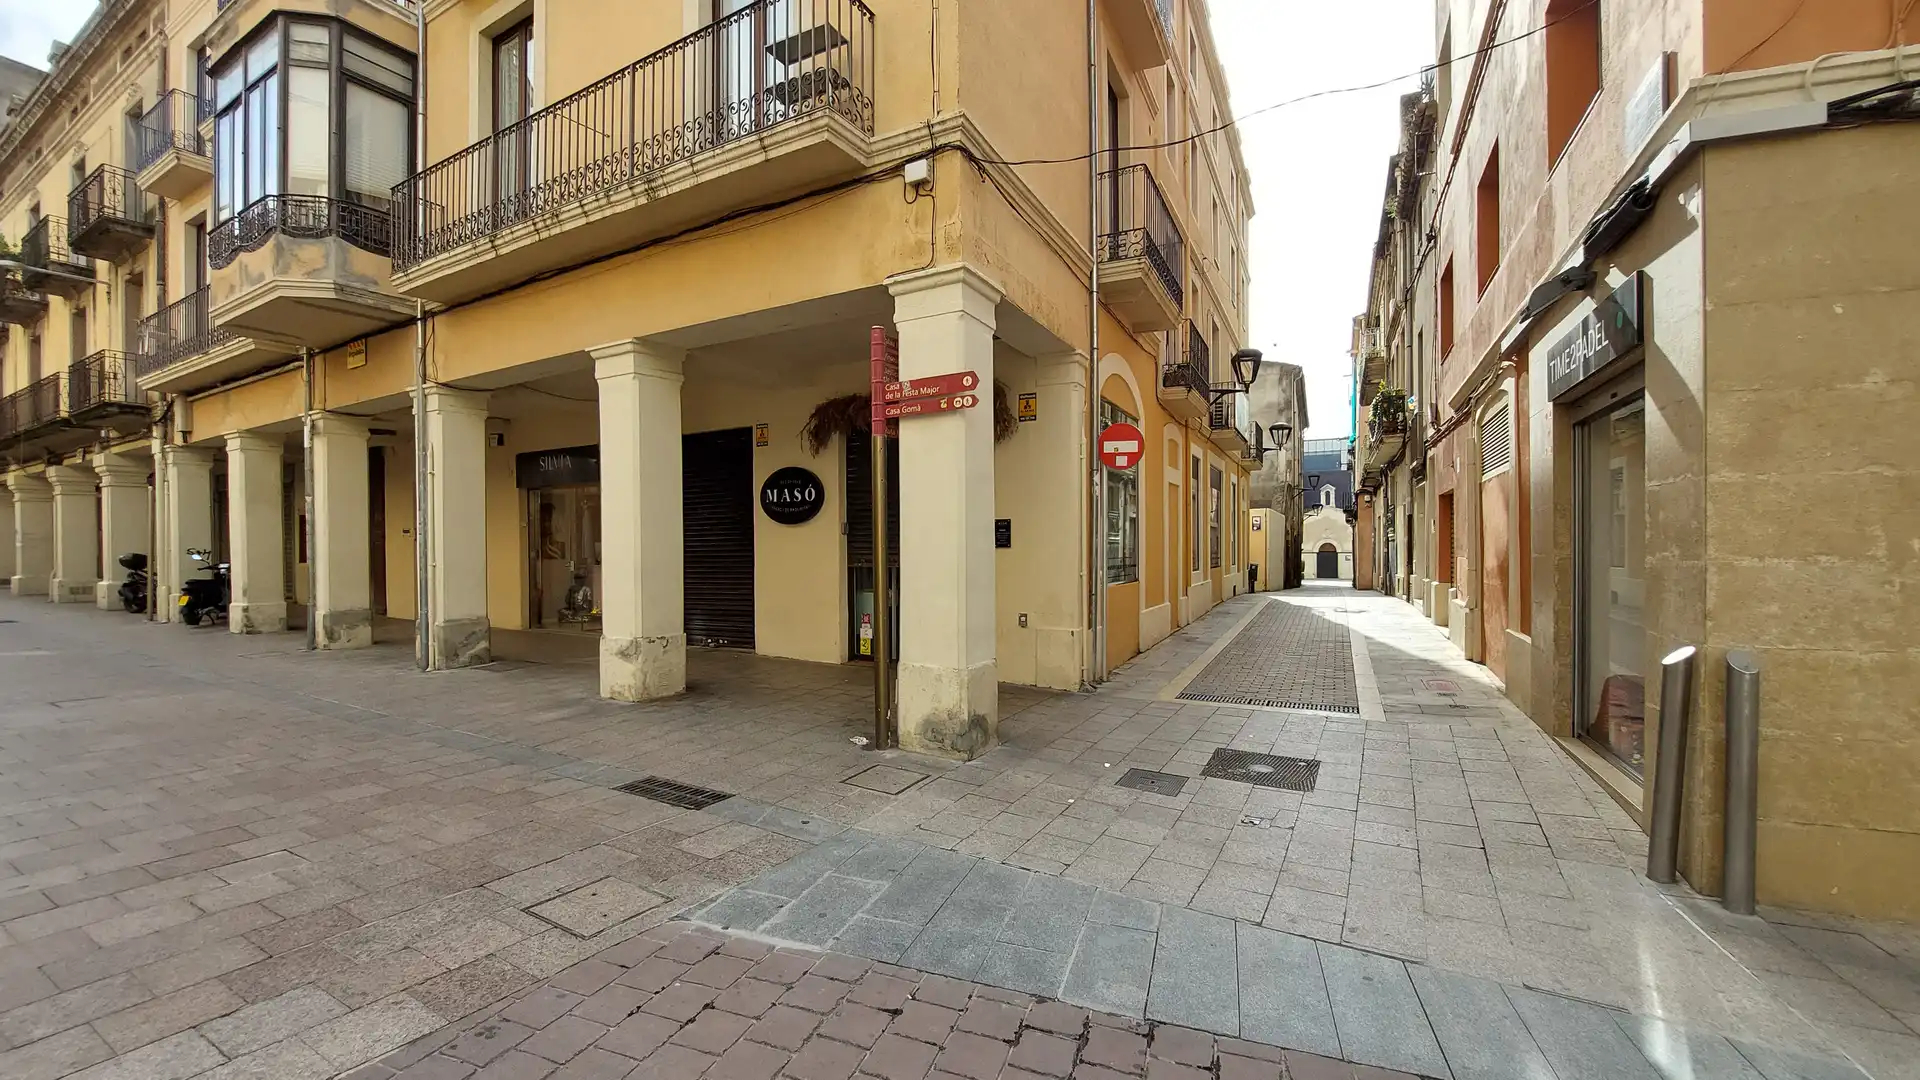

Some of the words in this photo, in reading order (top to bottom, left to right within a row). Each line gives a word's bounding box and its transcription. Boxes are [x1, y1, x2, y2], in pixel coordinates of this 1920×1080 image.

[1549, 320, 1609, 384] TIME2PADEL
[885, 383, 900, 391] Casa
[885, 392, 893, 400] de
[894, 391, 900, 399] la
[920, 386, 940, 396] Major
[902, 404, 920, 413] Gomà
[766, 483, 816, 503] MASÓ
